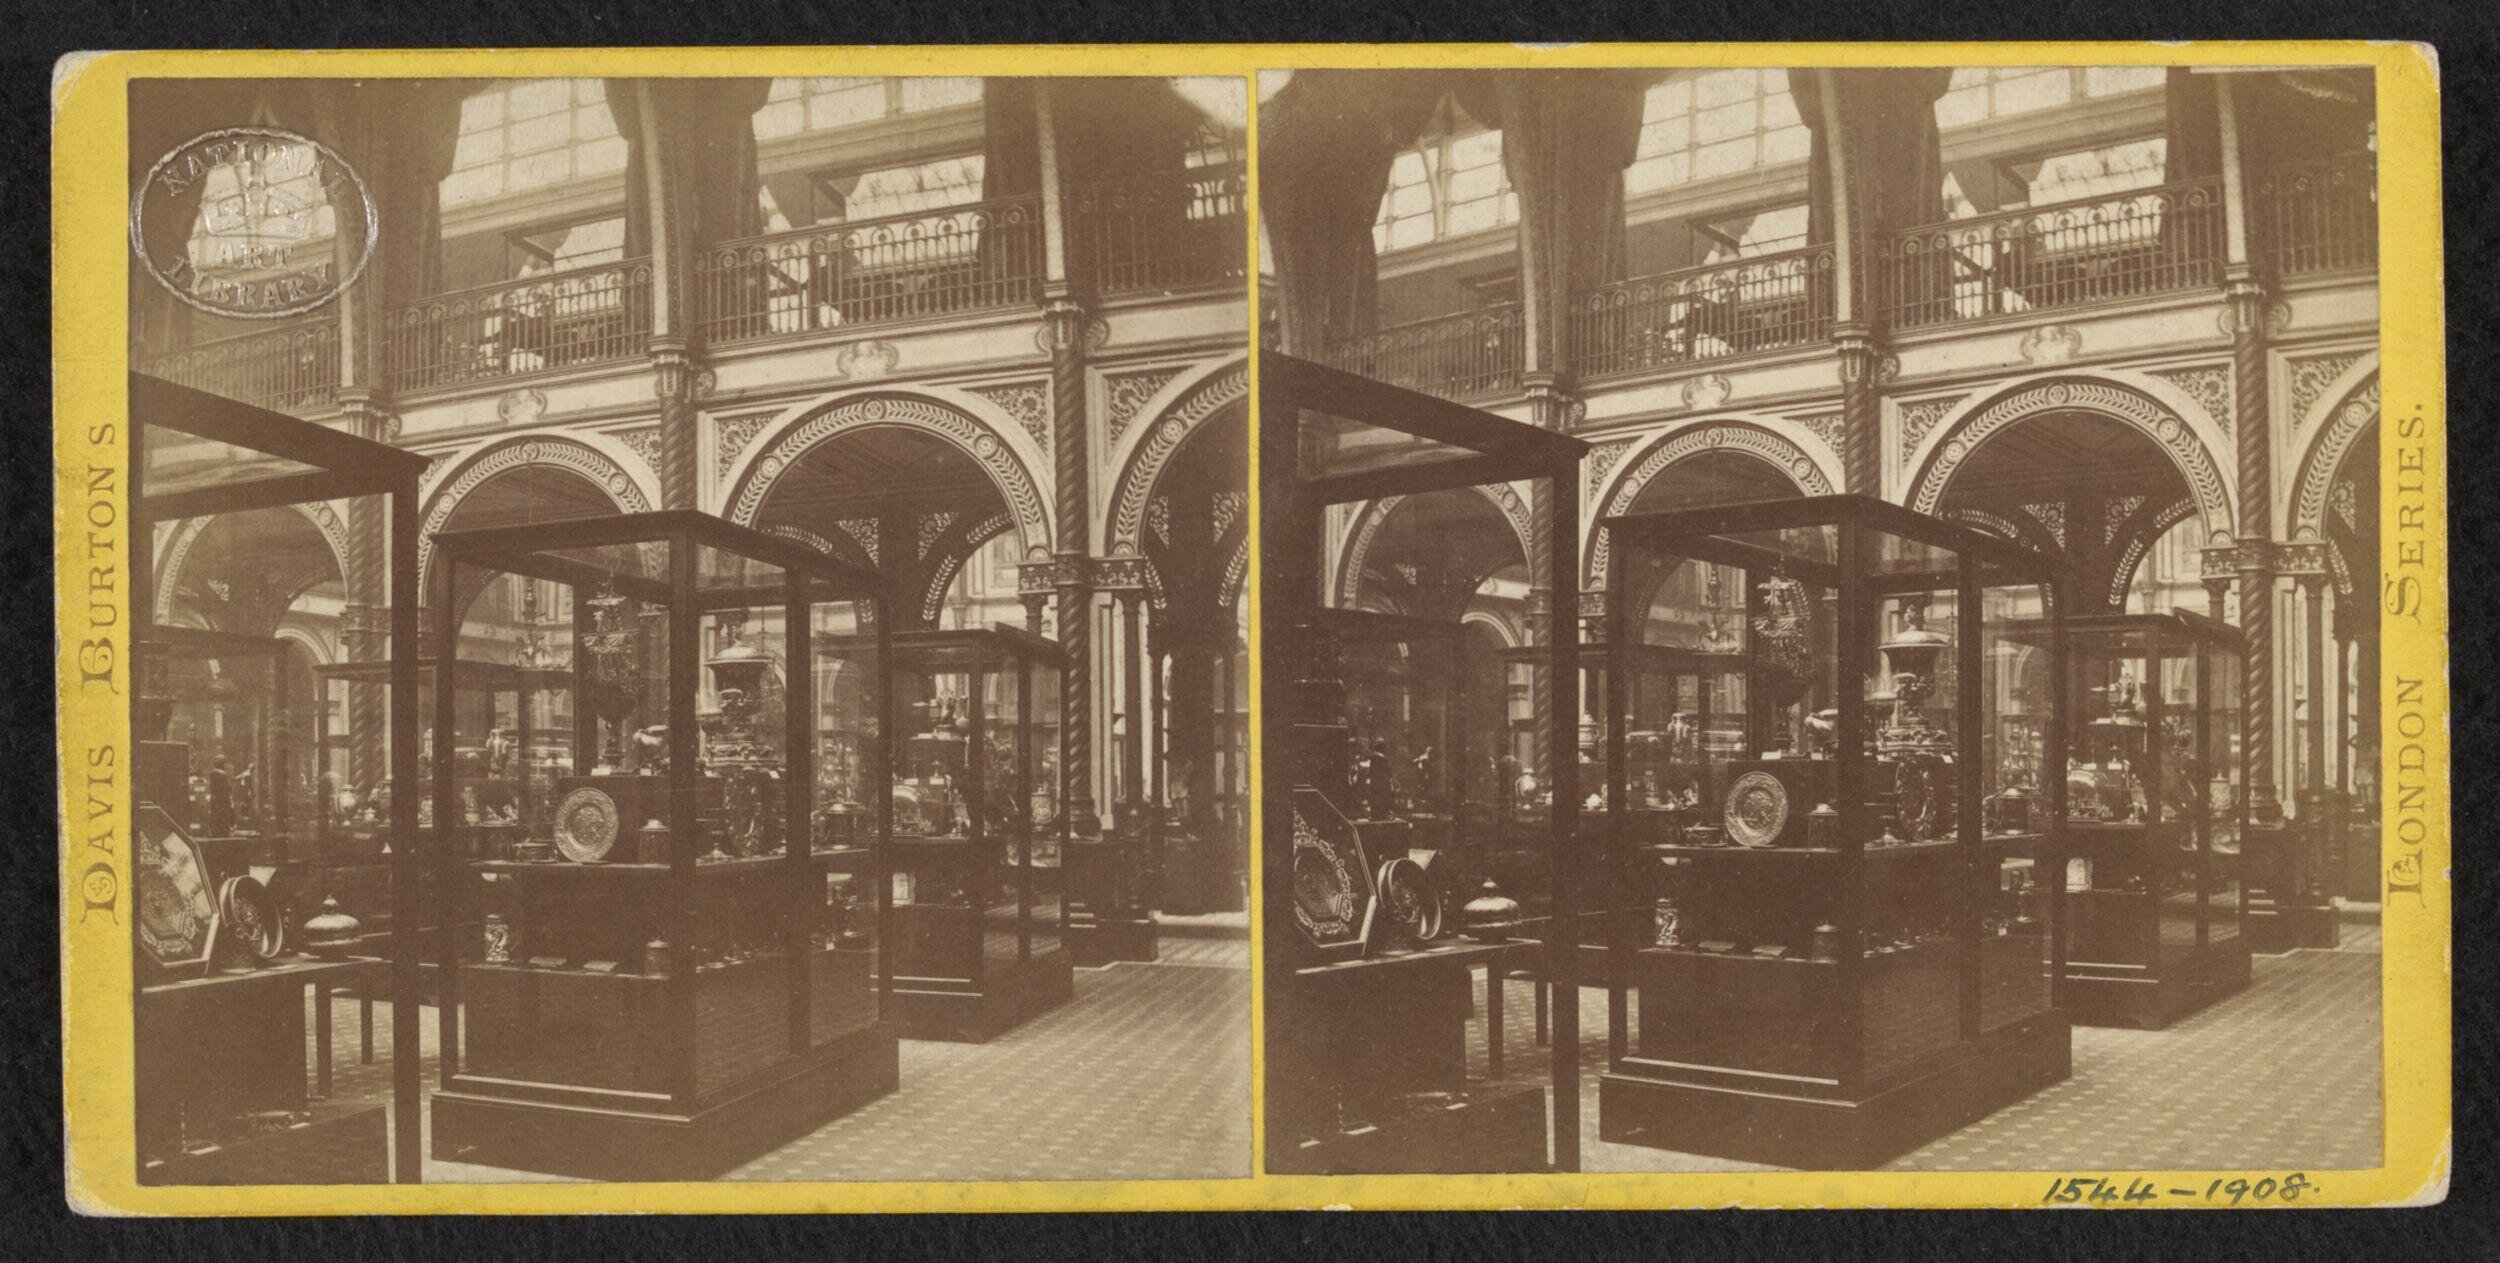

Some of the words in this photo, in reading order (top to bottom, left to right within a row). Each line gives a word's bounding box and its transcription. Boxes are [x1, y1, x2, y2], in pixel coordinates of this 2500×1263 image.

[156, 140, 348, 197] NATIONAL
[162, 255, 333, 308] LIBRARY
[214, 245, 295, 271] ART
[2384, 403, 2424, 625] SERIES.
[79, 744, 120, 926] DAVIS
[2386, 676, 2428, 908] LONDON
